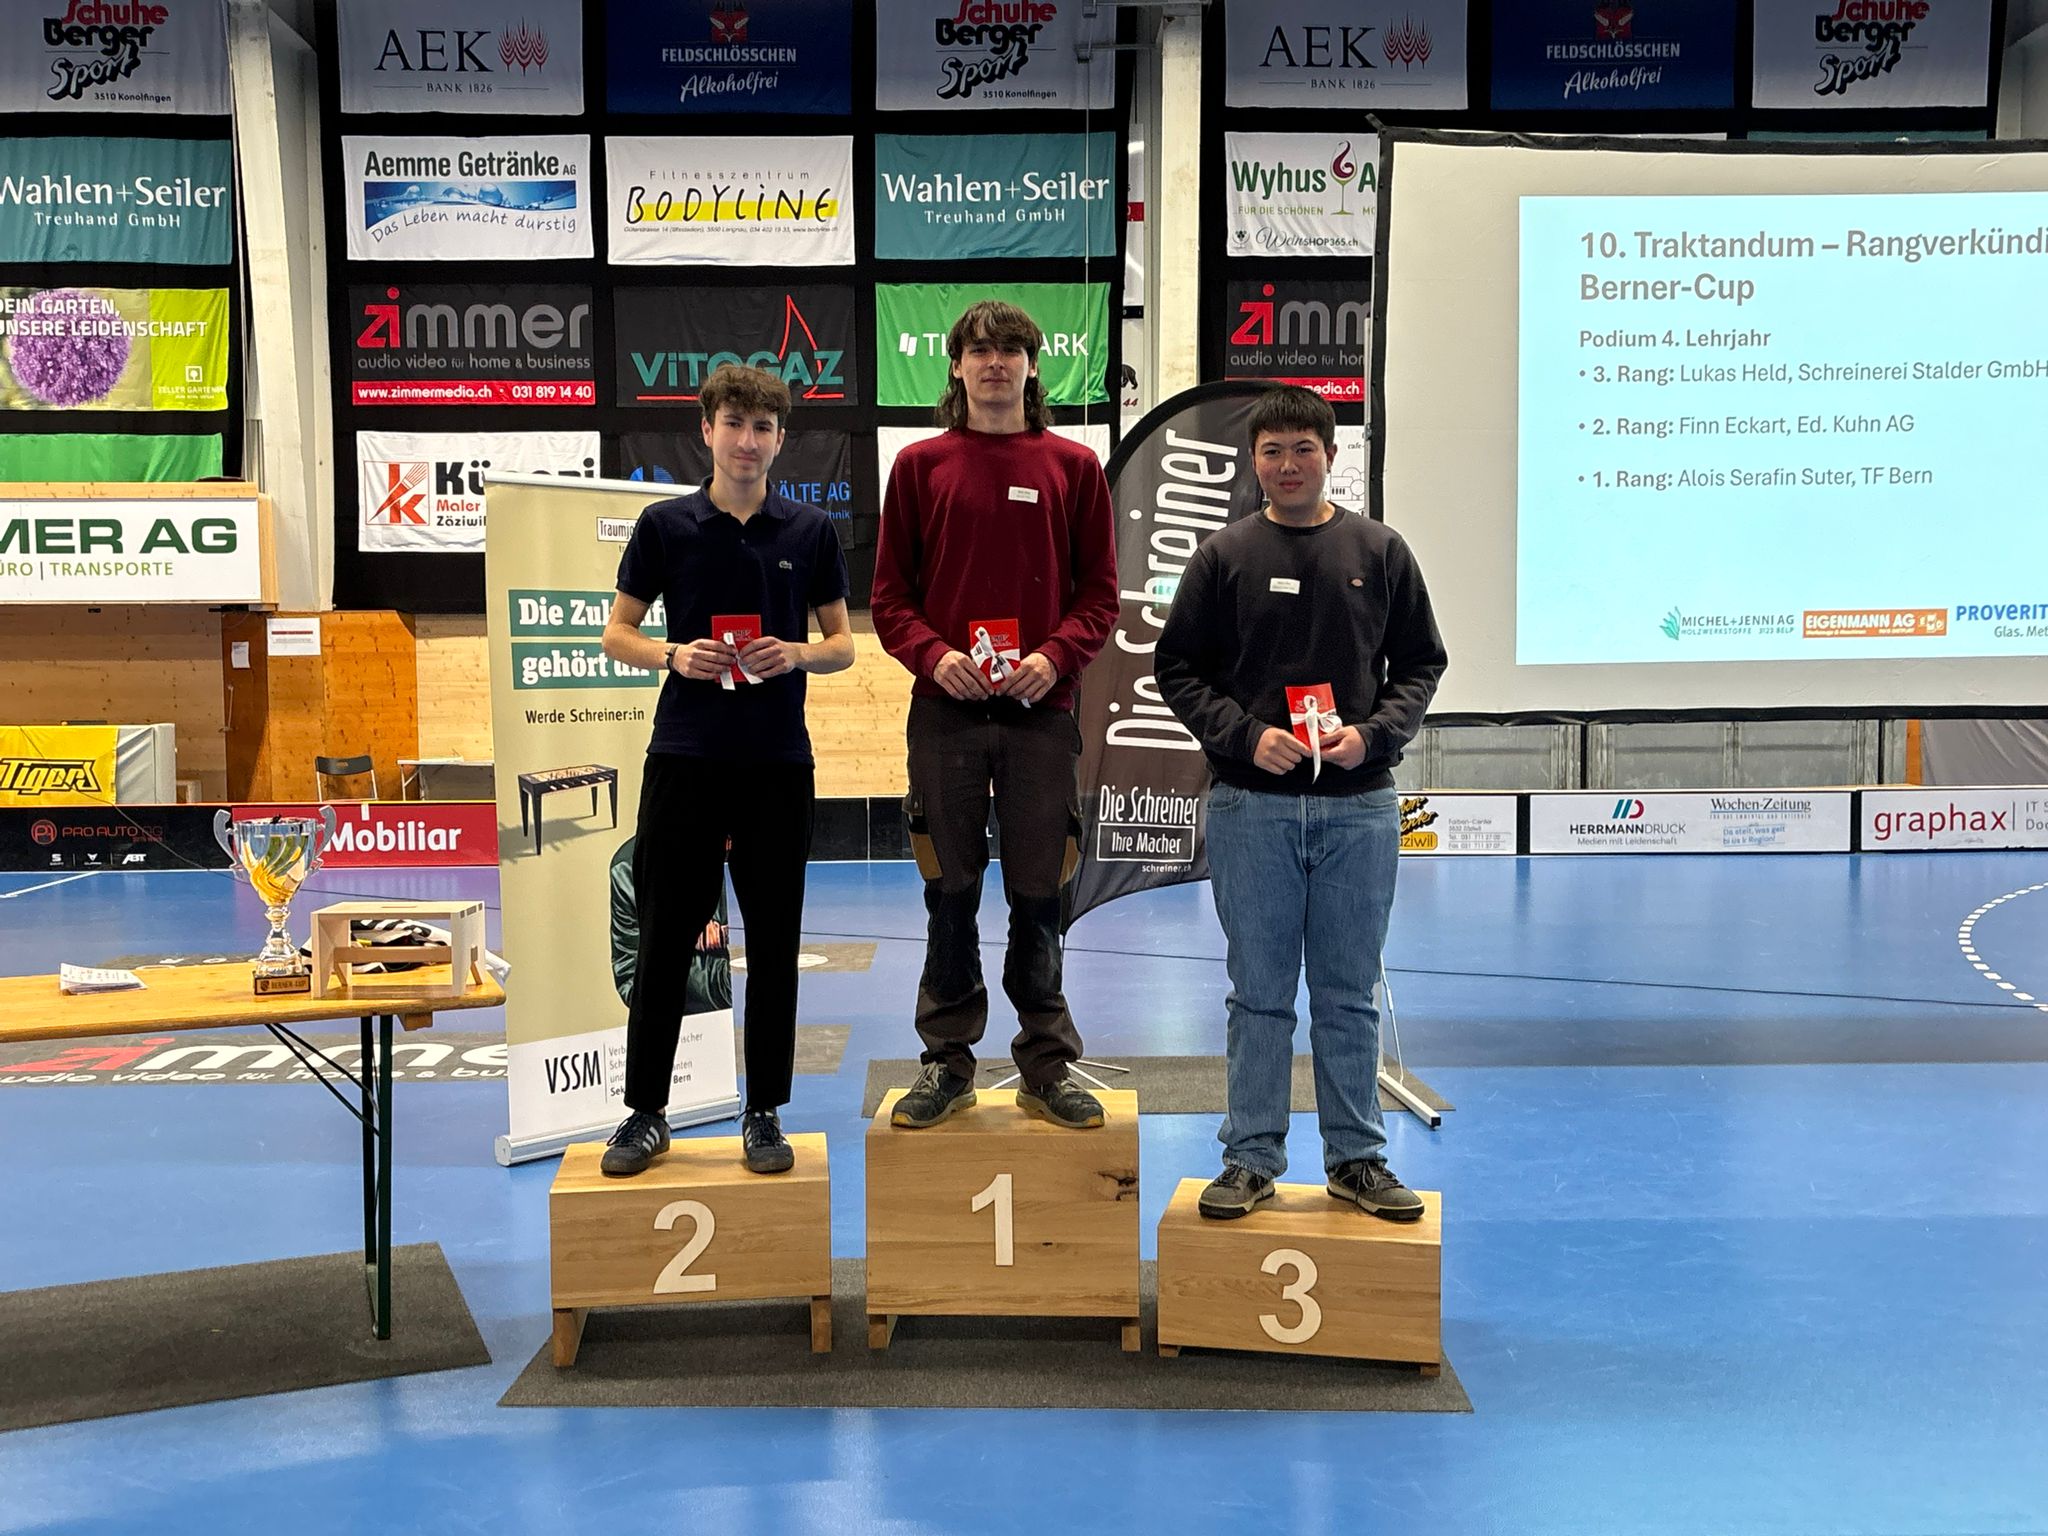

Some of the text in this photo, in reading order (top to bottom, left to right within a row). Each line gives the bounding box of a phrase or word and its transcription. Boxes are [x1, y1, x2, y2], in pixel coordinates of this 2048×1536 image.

[62, 0, 168, 26] Schuhe
[954, 0, 1057, 25] Schuhe
[43, 17, 154, 56] Berger
[935, 18, 1042, 55] Berger
[1815, 15, 1916, 52] Berger
[374, 29, 495, 74] AEK
[662, 45, 797, 64] FELDSCHLÖSSCHEN
[1260, 25, 1378, 69] AEK
[1545, 41, 1681, 60] FELDSCHLÖSSCHEN
[47, 41, 141, 100] Sport
[936, 38, 1029, 99] Sport
[1814, 35, 1902, 95] Sport
[426, 82, 494, 94] BANK 1826
[680, 71, 779, 102] Alkoholfrei
[1005, 88, 1057, 100] Konolfingen
[1310, 78, 1376, 90] BANK 1826
[1564, 66, 1662, 99] Alkoholfrei
[118, 92, 172, 103] Konolfingen
[364, 150, 577, 178] Aemme Getränke AG
[650, 170, 811, 181] Fitnesszentrum
[0, 174, 227, 208] Wahlen+Seiler
[881, 171, 1110, 203] Wahlen+Seiler
[1232, 160, 1326, 200] Wyhus
[34, 211, 181, 229] Treuhand GmbH
[924, 208, 1066, 224] Treuhand GmbH
[1259, 206, 1275, 215] DIE
[1278, 205, 1324, 216] SCHÖNEN
[371, 210, 577, 243] Das Leben macht durstig
[1580, 232, 1627, 259] 10.
[1633, 231, 1815, 259] Traktandum
[1580, 273, 1755, 305] Berner-Cup
[41, 298, 121, 317] GARTEN,
[357, 287, 590, 348] zimmer
[71, 320, 209, 338] LEIDENSCHAFT
[1580, 329, 1772, 350] Podium 4. Lehrjahr
[357, 352, 591, 369] audio video für home & business
[1230, 350, 1335, 366] audio video für
[1593, 361, 2048, 386] 3. Rang: Lukas Held, Schreinerei Stalder GmbH
[358, 385, 592, 401] www.zimmermedia.ch 031 819 14 40
[1592, 414, 1916, 439] 2. Rang: Finn Eckart, Ed. Kuhn AG
[1592, 467, 1933, 491] 1. Rang: Alois Serafin Suter, TF Bern
[779, 480, 851, 504] ÄLTE AG
[436, 499, 481, 512] Maler
[139, 518, 238, 554] AG
[50, 562, 174, 577] TRANSPORTE
[518, 596, 564, 626] Die
[1681, 614, 1796, 627] MICHEL+JENNI AG
[1805, 613, 1916, 629] EIGENMANN AG
[522, 649, 609, 685] gehört
[525, 708, 645, 724] Werde Schreiner:in
[1099, 785, 1199, 826] Die Schreiner
[1711, 798, 1812, 813] Wochen-Zeitung
[2025, 801, 2039, 813] IT
[62, 826, 95, 838] PRO
[96, 826, 139, 838] AUTO
[1570, 823, 1686, 835] HERRMANNDRUCK
[1874, 802, 2007, 841] graphax
[328, 822, 463, 855] Mobiliar
[1111, 830, 1182, 855] Ihre Macher
[1577, 837, 1678, 846] Medien mit Leidenschaft
[122, 853, 147, 865] ABT
[112, 1070, 226, 1082] video
[545, 1050, 601, 1094] VSSM
[673, 1074, 692, 1084] Bern
[971, 1173, 1012, 1267] 1
[653, 1200, 717, 1294] 2
[1257, 1248, 1322, 1345] 3
